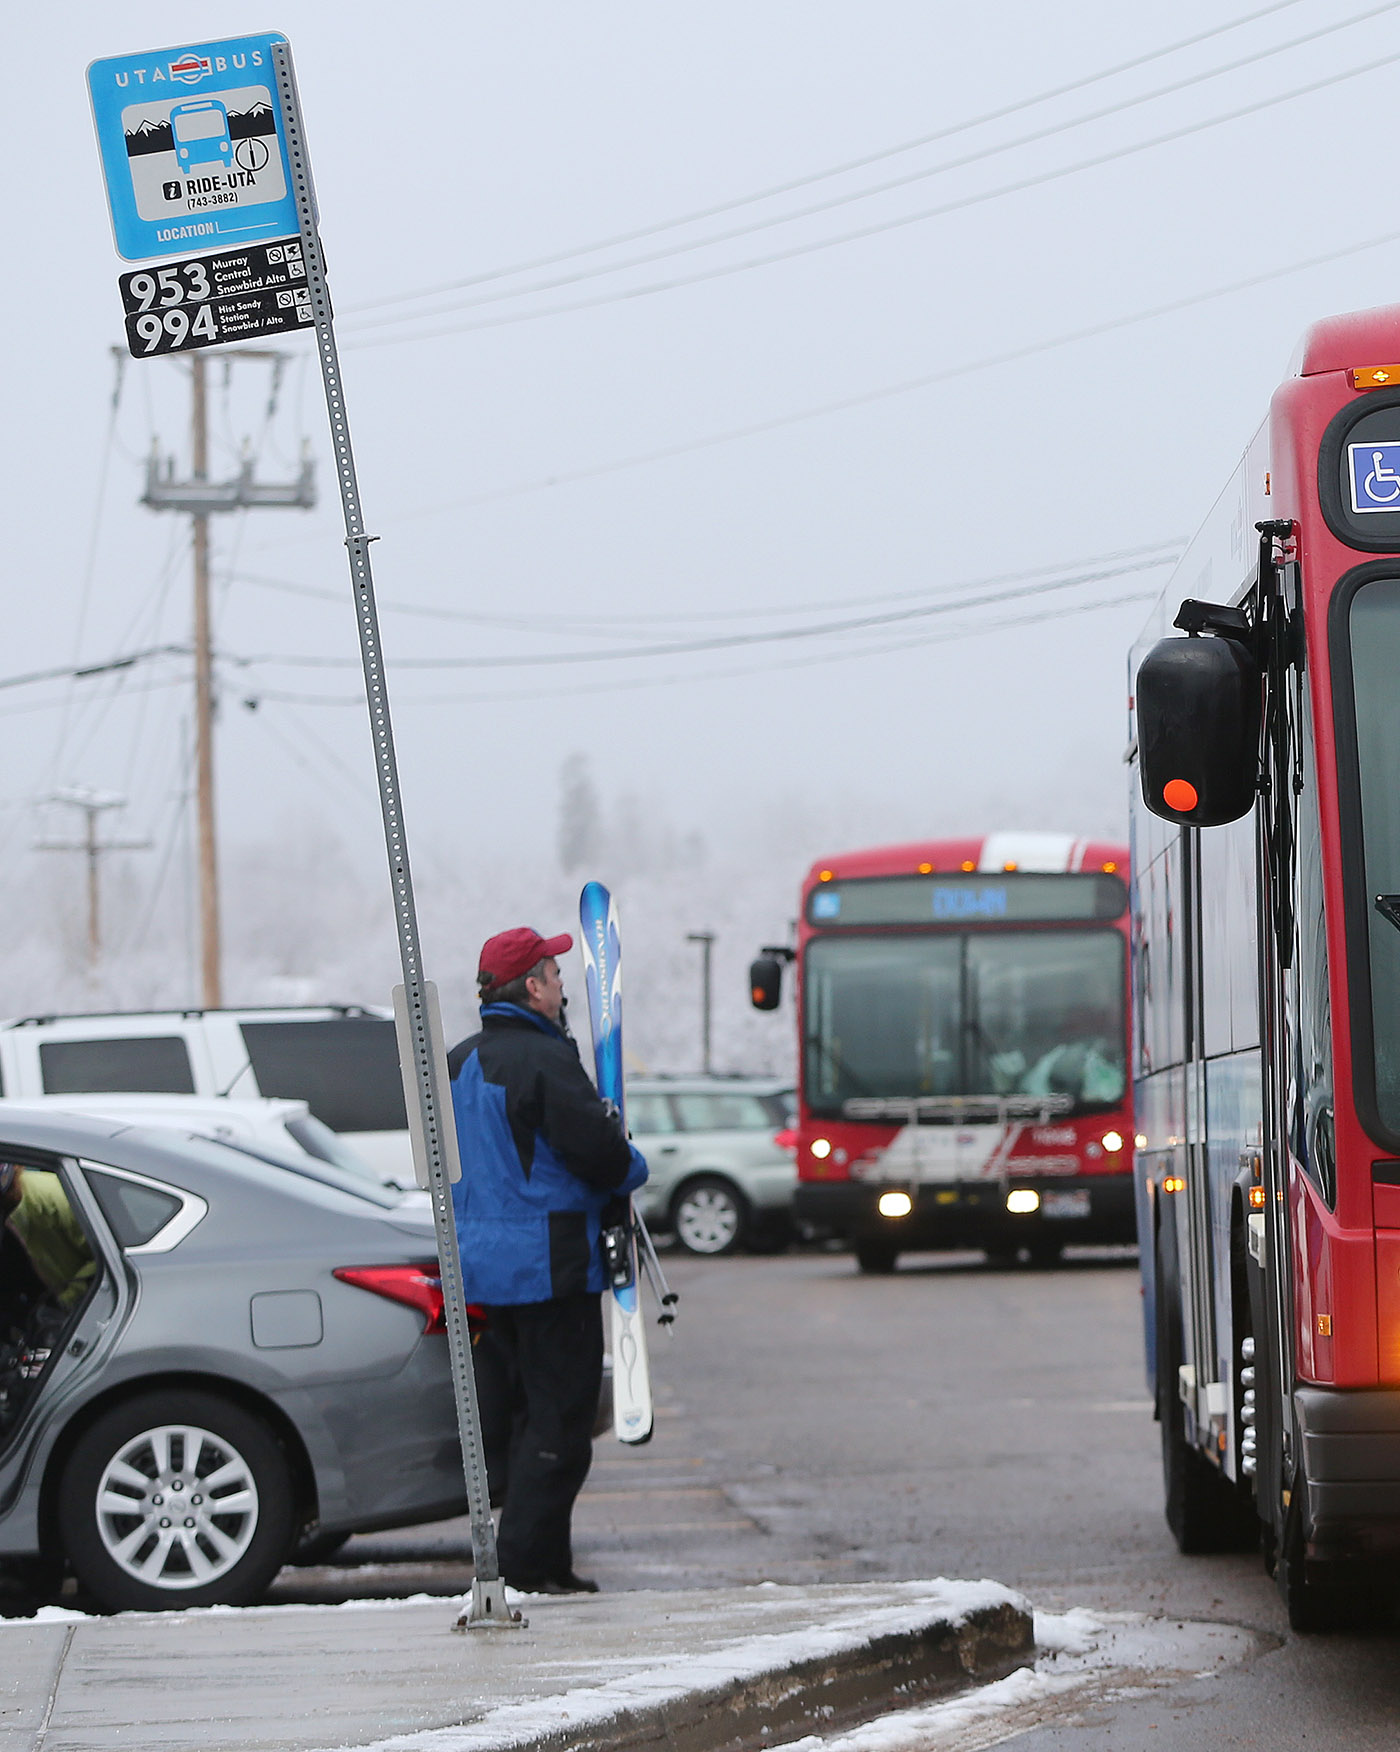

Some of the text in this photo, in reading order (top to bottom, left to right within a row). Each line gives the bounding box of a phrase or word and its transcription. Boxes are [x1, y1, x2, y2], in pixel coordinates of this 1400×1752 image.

[115, 50, 263, 87] UTA BUS
[186, 171, 256, 195] RIDE-UTA
[187, 192, 238, 211] (743-3882)
[157, 222, 214, 242] LOCATION
[212, 257, 248, 270] Murray
[214, 266, 252, 282] Central
[129, 262, 211, 312] 953
[217, 274, 286, 295] Snowbird Alta
[218, 300, 262, 314] Hist Sandy
[220, 313, 250, 324] Station
[222, 319, 260, 334] Snowbird
[266, 317, 284, 326] Alta
[136, 304, 219, 353] 994
